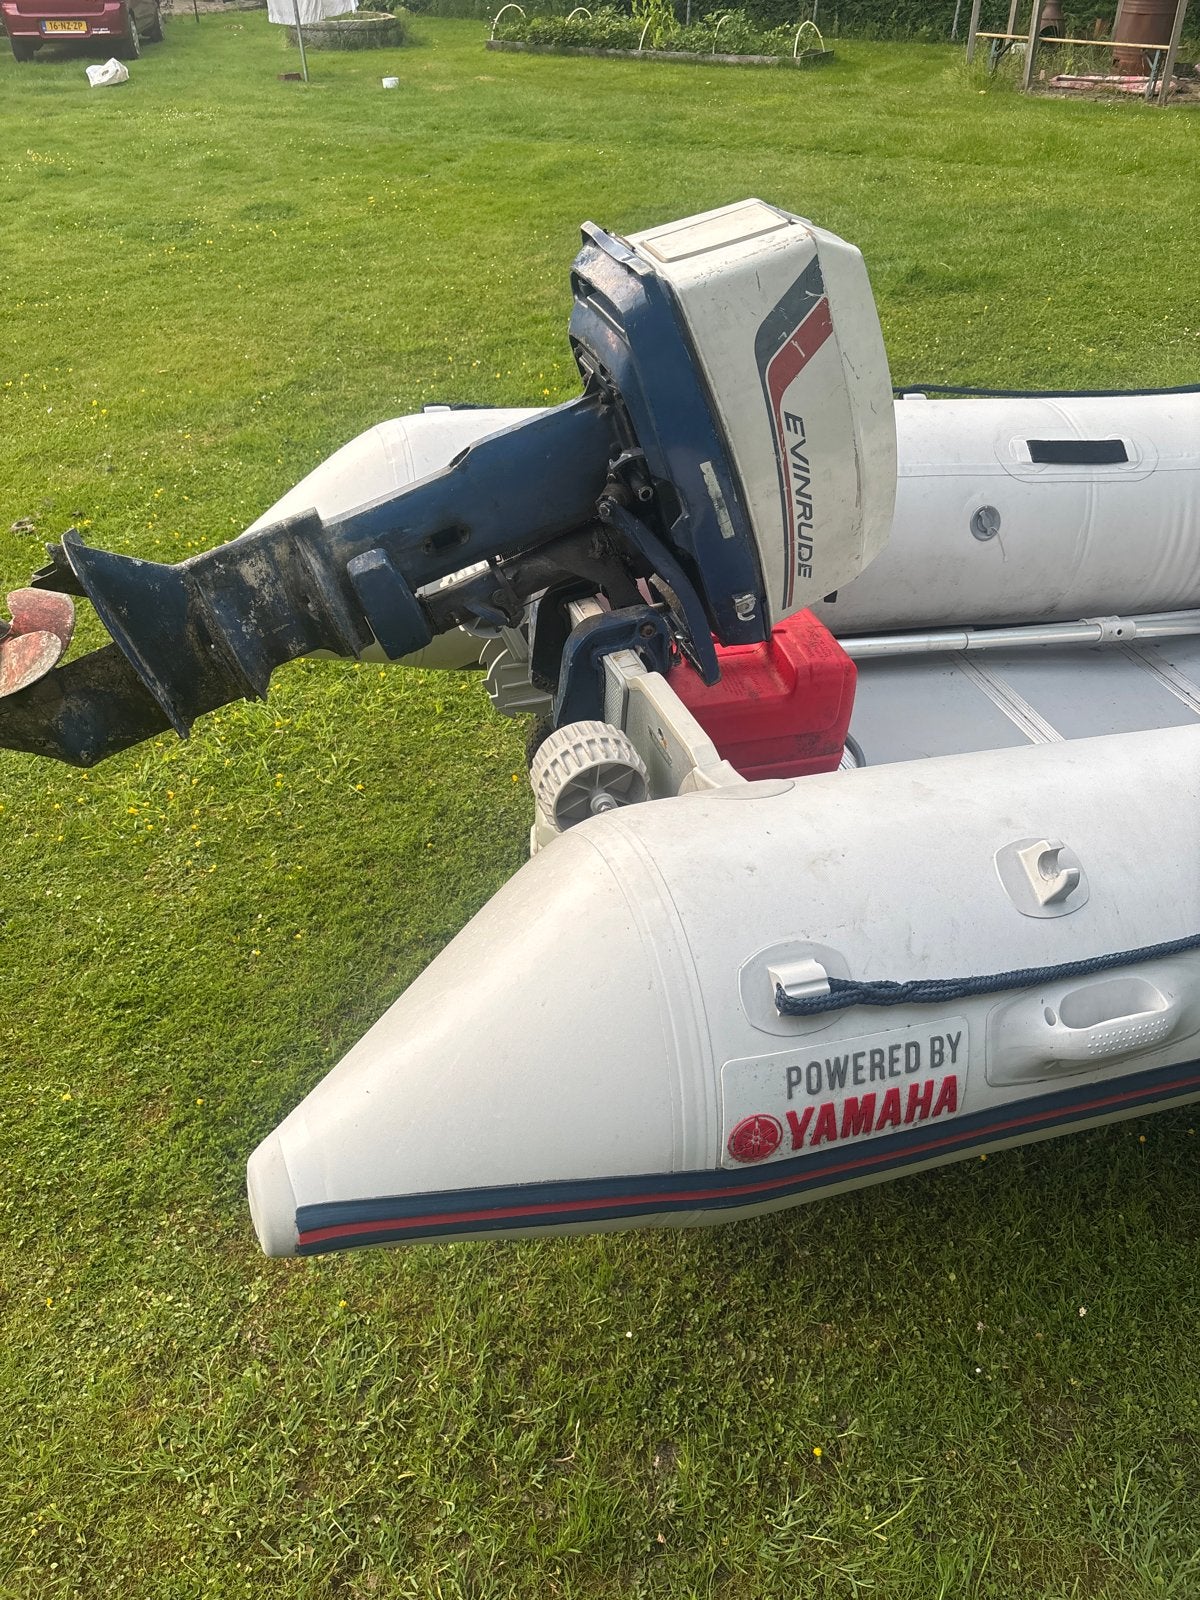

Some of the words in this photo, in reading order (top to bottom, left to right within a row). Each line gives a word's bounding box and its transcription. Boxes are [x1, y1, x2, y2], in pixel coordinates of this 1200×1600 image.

[49, 22, 83, 31] 16-NZ-ZP
[784, 411, 813, 579] EVINRUDE
[786, 1041, 921, 1100] POWERED
[929, 1030, 962, 1069] BY
[785, 1074, 958, 1151] YAMAHA
